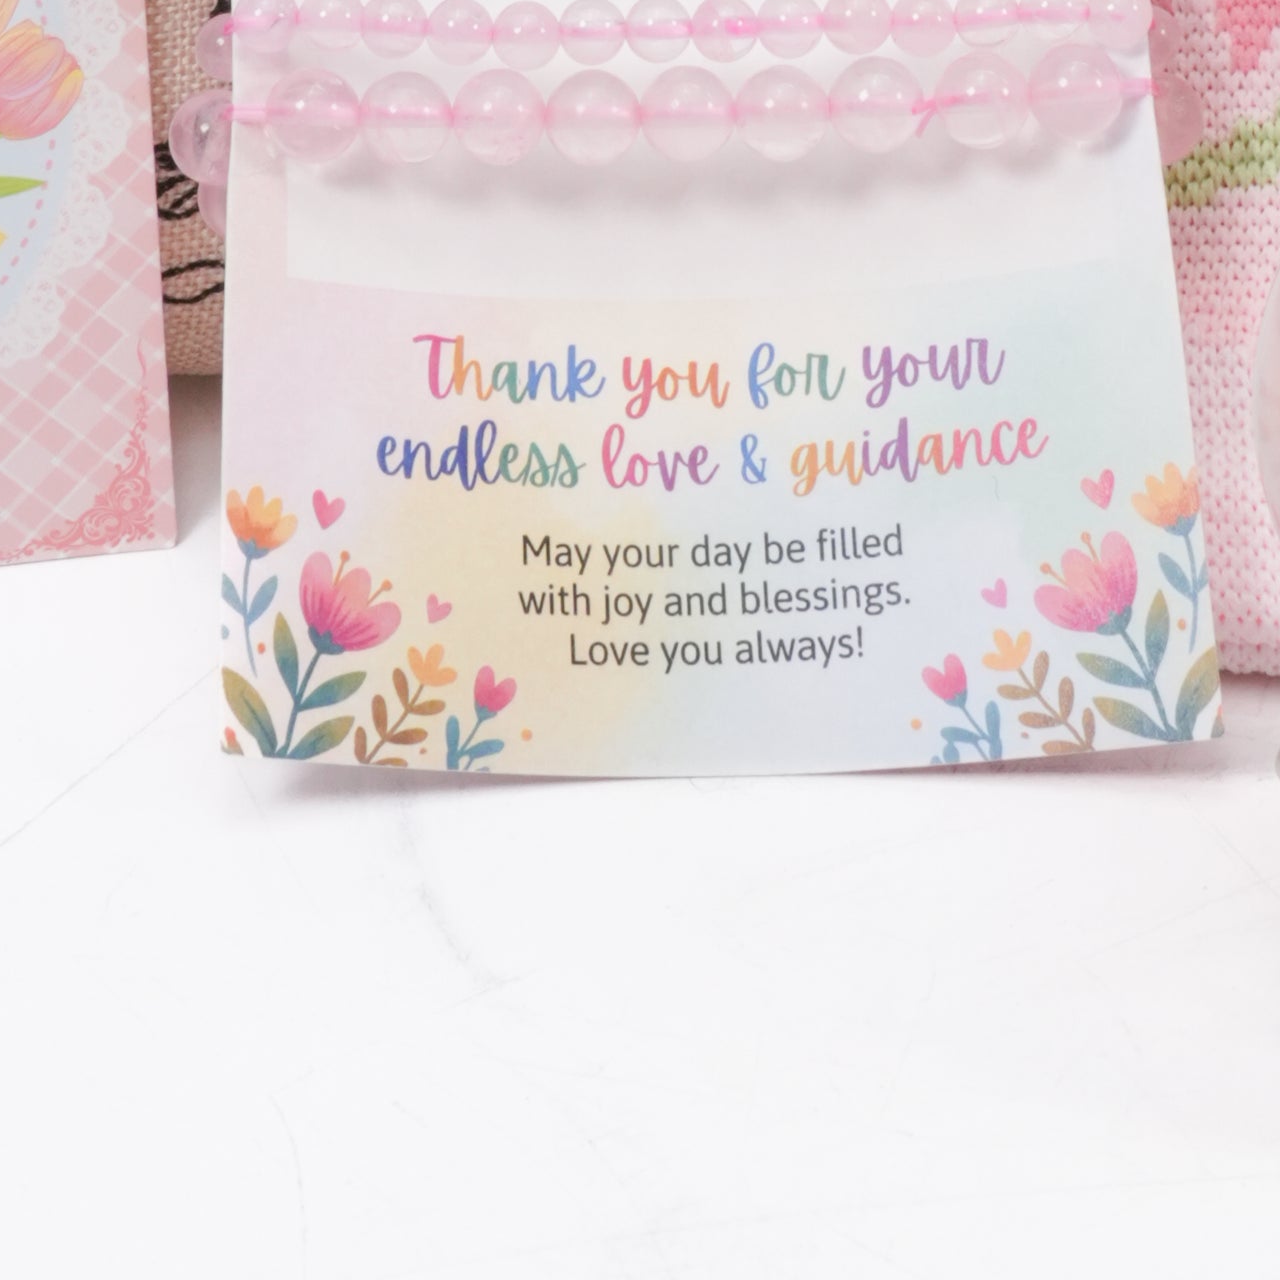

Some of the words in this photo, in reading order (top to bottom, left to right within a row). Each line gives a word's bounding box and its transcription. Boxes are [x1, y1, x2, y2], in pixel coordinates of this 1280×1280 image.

[412, 334, 605, 403] Thank
[622, 355, 729, 418] you
[748, 342, 846, 409] for
[862, 337, 1006, 408] your
[376, 420, 586, 489] endless
[601, 423, 720, 491] love
[739, 433, 768, 483] &
[790, 417, 1050, 497] guidance
[522, 535, 592, 574] May
[603, 538, 680, 574] your
[691, 533, 752, 574] day
[763, 530, 806, 564] be
[815, 524, 904, 563] filled
[518, 585, 592, 618] with
[601, 585, 653, 624] joy
[664, 582, 728, 617] and
[740, 577, 912, 621] blessings.
[569, 634, 650, 667] Love
[660, 639, 724, 674] you
[734, 627, 865, 672] always!
